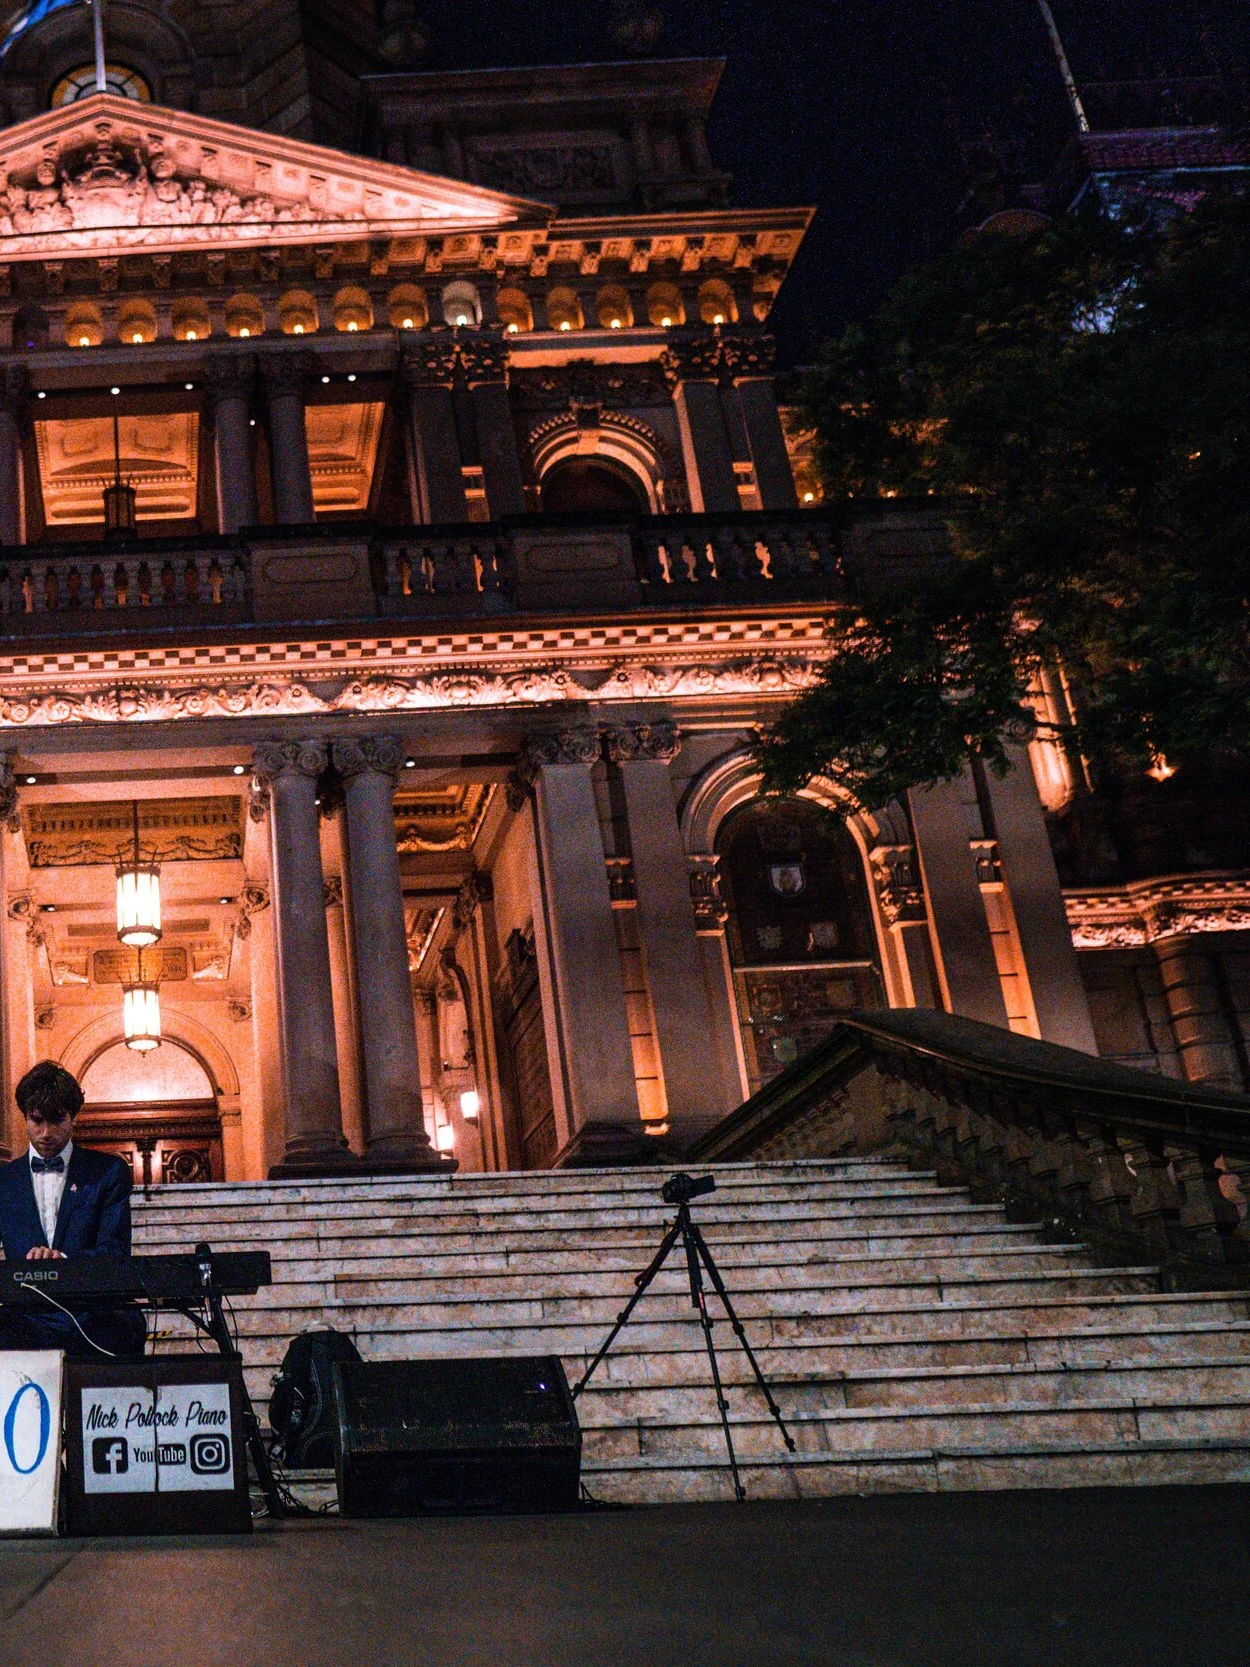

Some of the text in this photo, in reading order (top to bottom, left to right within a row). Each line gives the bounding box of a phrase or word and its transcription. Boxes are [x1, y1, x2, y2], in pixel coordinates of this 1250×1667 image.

[13, 1271, 59, 1282] CASIO
[86, 1400, 228, 1430] Nick Pollock Piano
